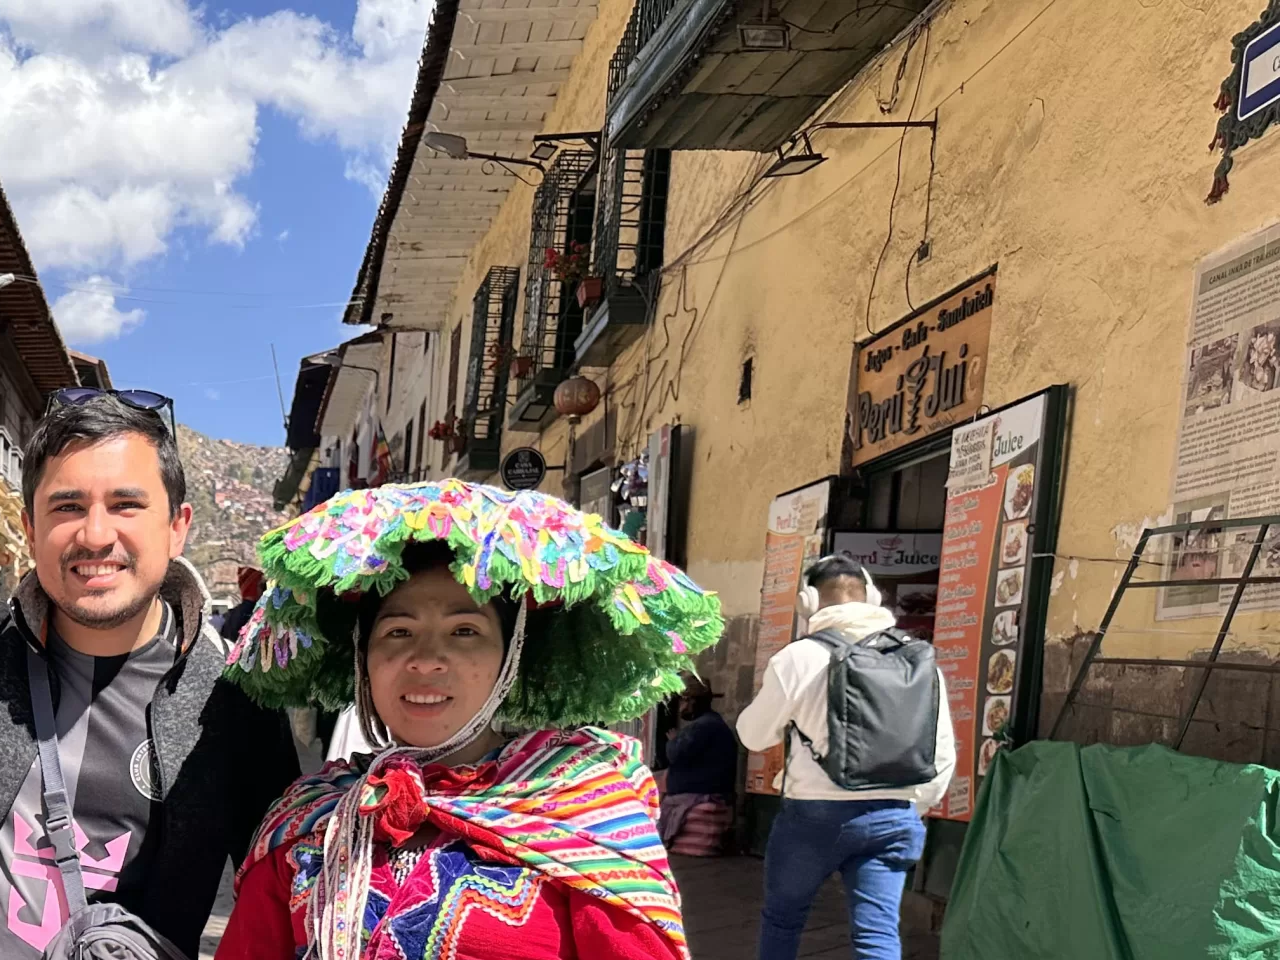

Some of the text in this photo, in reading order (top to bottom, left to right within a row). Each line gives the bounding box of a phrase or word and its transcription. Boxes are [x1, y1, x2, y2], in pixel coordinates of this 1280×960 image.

[936, 283, 993, 332] Sandwich
[993, 430, 1024, 458] Juice
[894, 550, 938, 565] Juice
